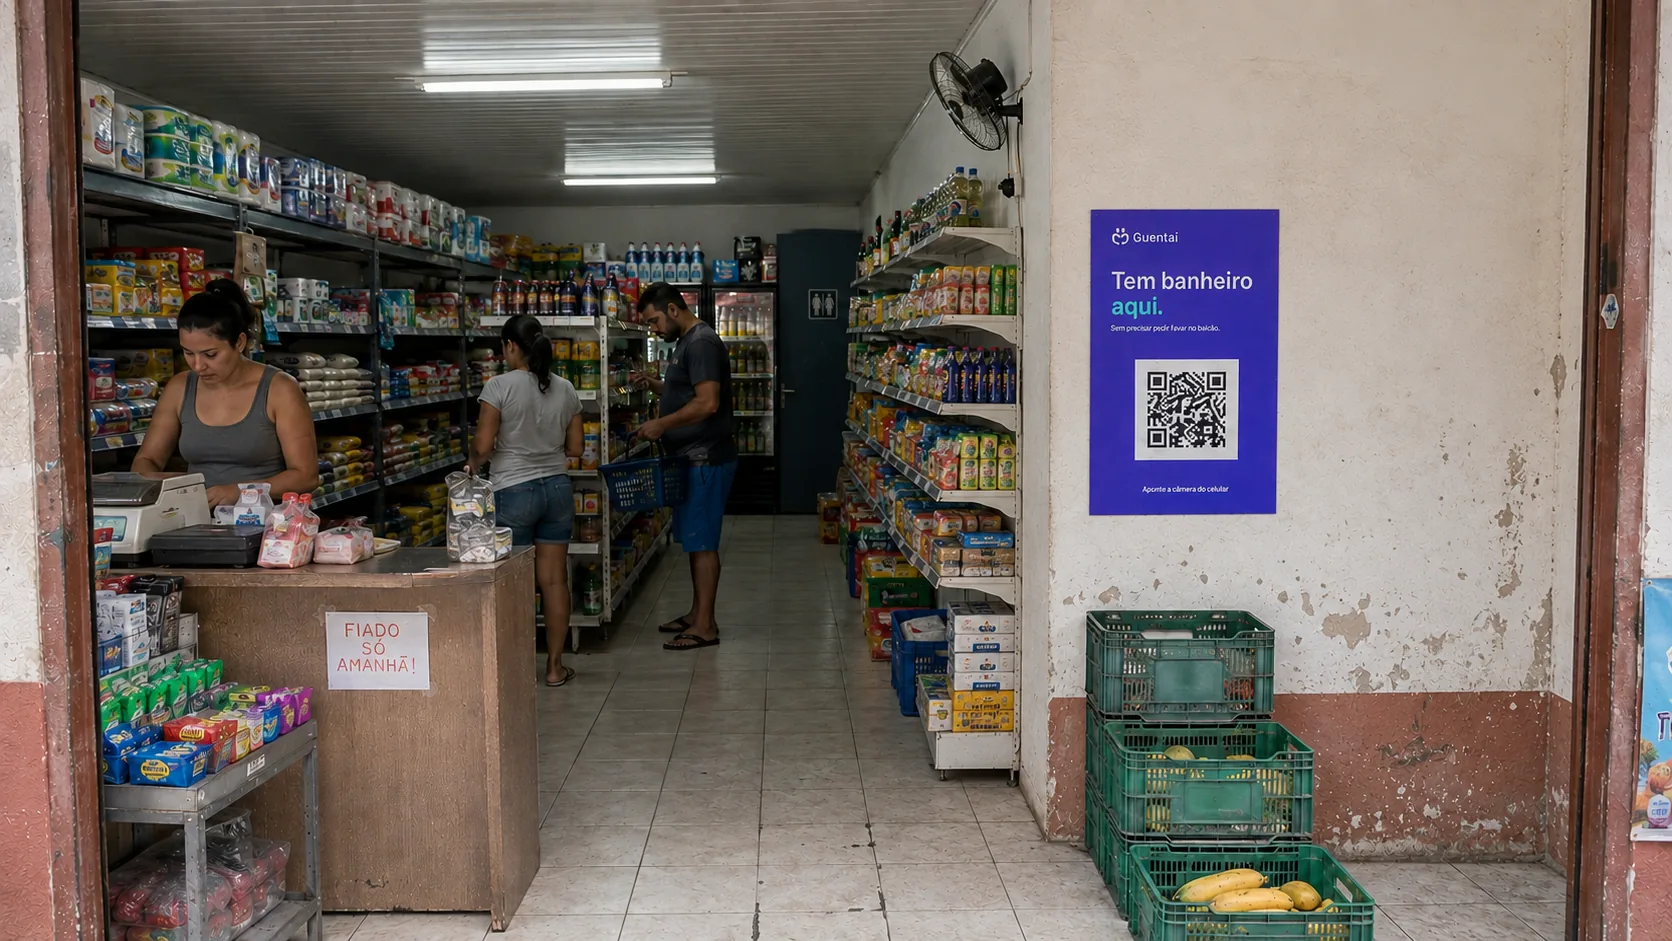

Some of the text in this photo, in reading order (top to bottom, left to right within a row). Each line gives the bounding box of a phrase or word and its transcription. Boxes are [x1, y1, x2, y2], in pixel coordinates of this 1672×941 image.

[1111, 271, 1253, 290] Tem banheiro
[1112, 296, 1163, 319] aqui.
[1142, 486, 1166, 494] Aponte
[1206, 485, 1229, 493] celular
[345, 623, 400, 637] FIADO
[362, 638, 385, 655] SÓ
